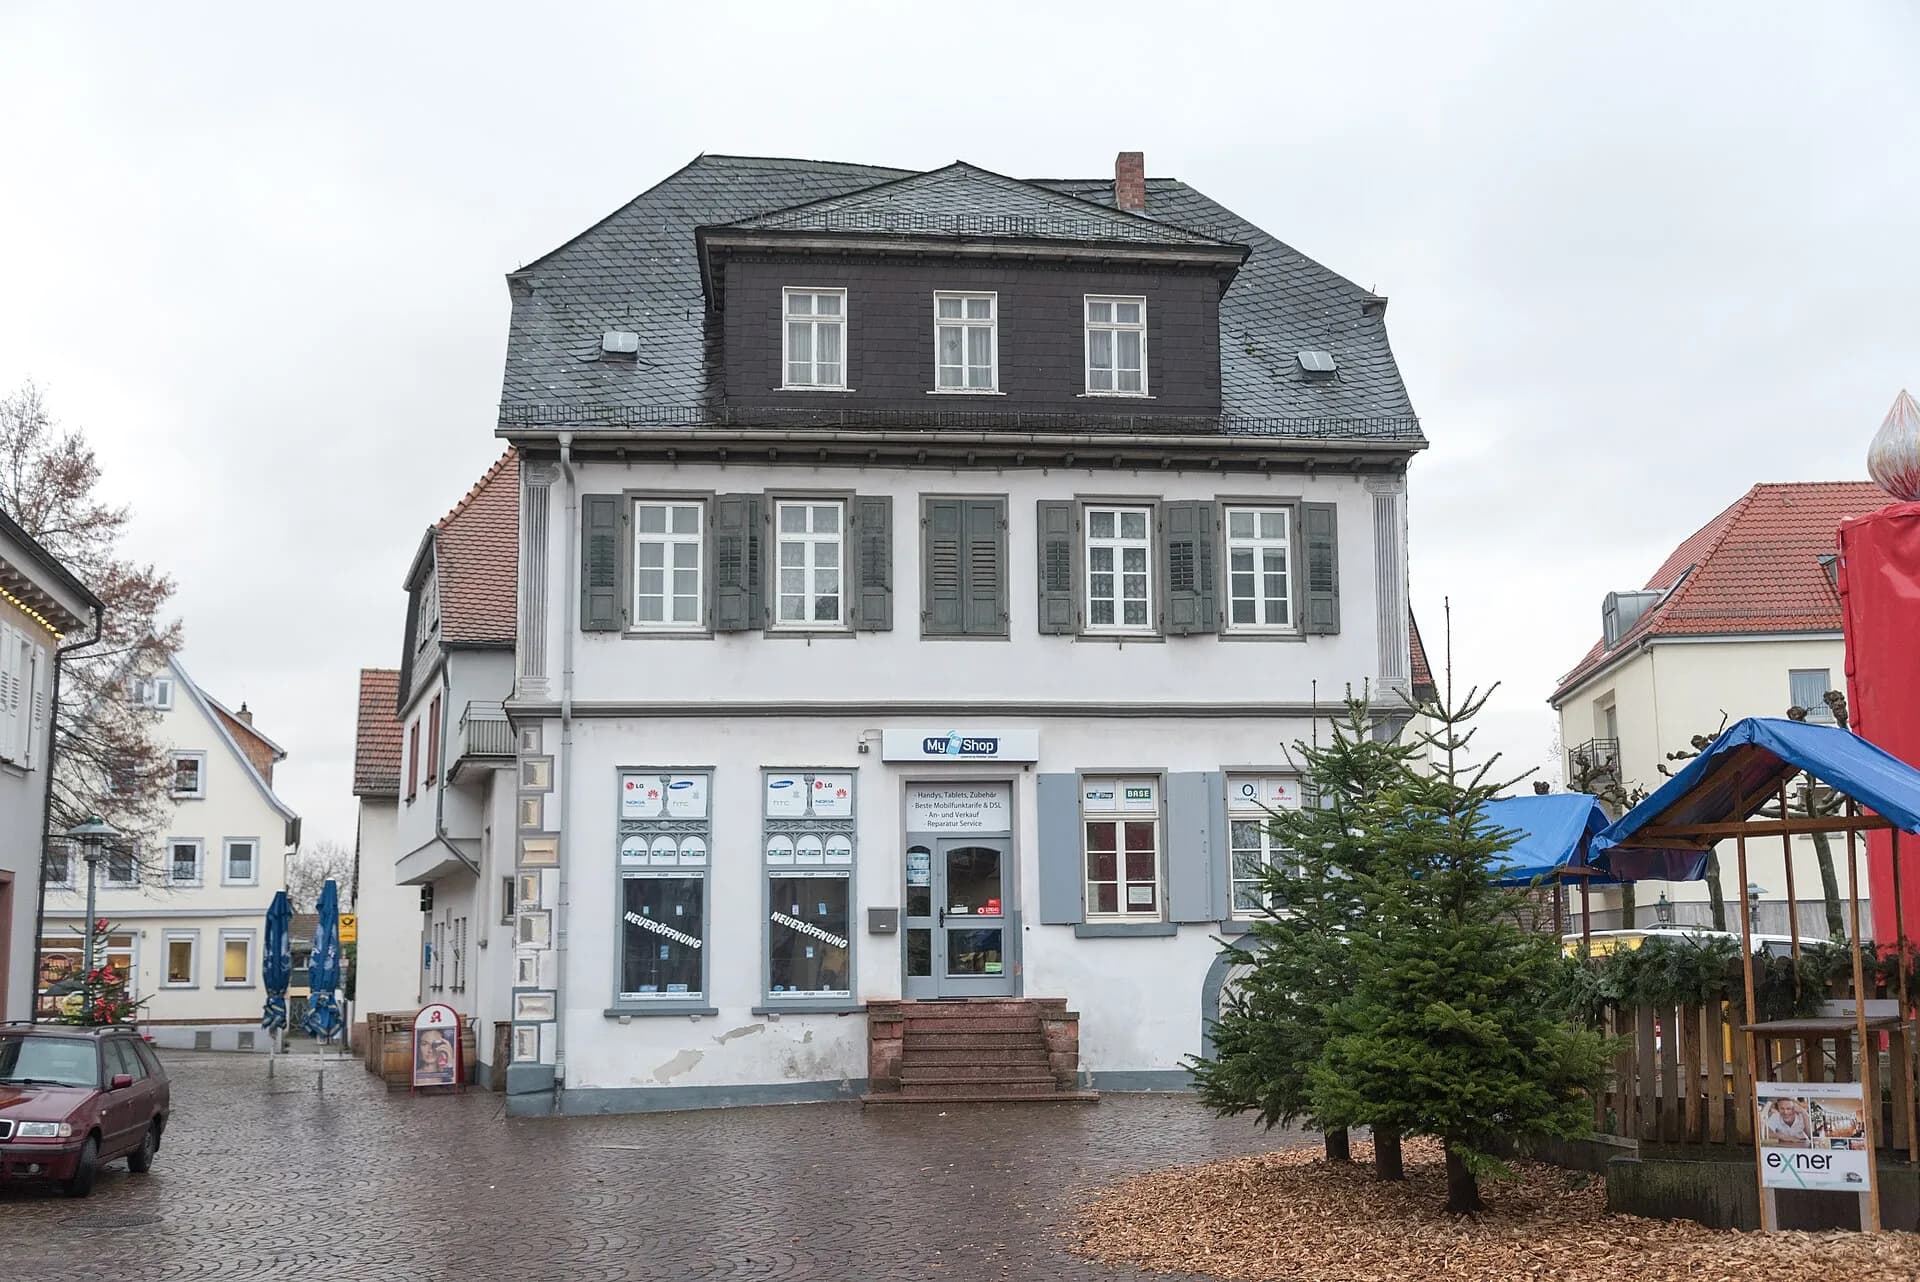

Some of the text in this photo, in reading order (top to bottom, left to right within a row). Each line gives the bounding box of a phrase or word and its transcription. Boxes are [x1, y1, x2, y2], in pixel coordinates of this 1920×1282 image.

[927, 740, 994, 755] My Shop
[917, 791, 997, 800] Handys, Tablets, Zubehör
[1127, 790, 1150, 798] BASE
[933, 801, 982, 809] Mobilfunktarife
[928, 820, 958, 828] Reparatur
[624, 911, 702, 949] NEUERÖFFNUNG
[770, 911, 849, 949] NEUERÖFFNUNG
[1766, 1152, 1832, 1188] exner
